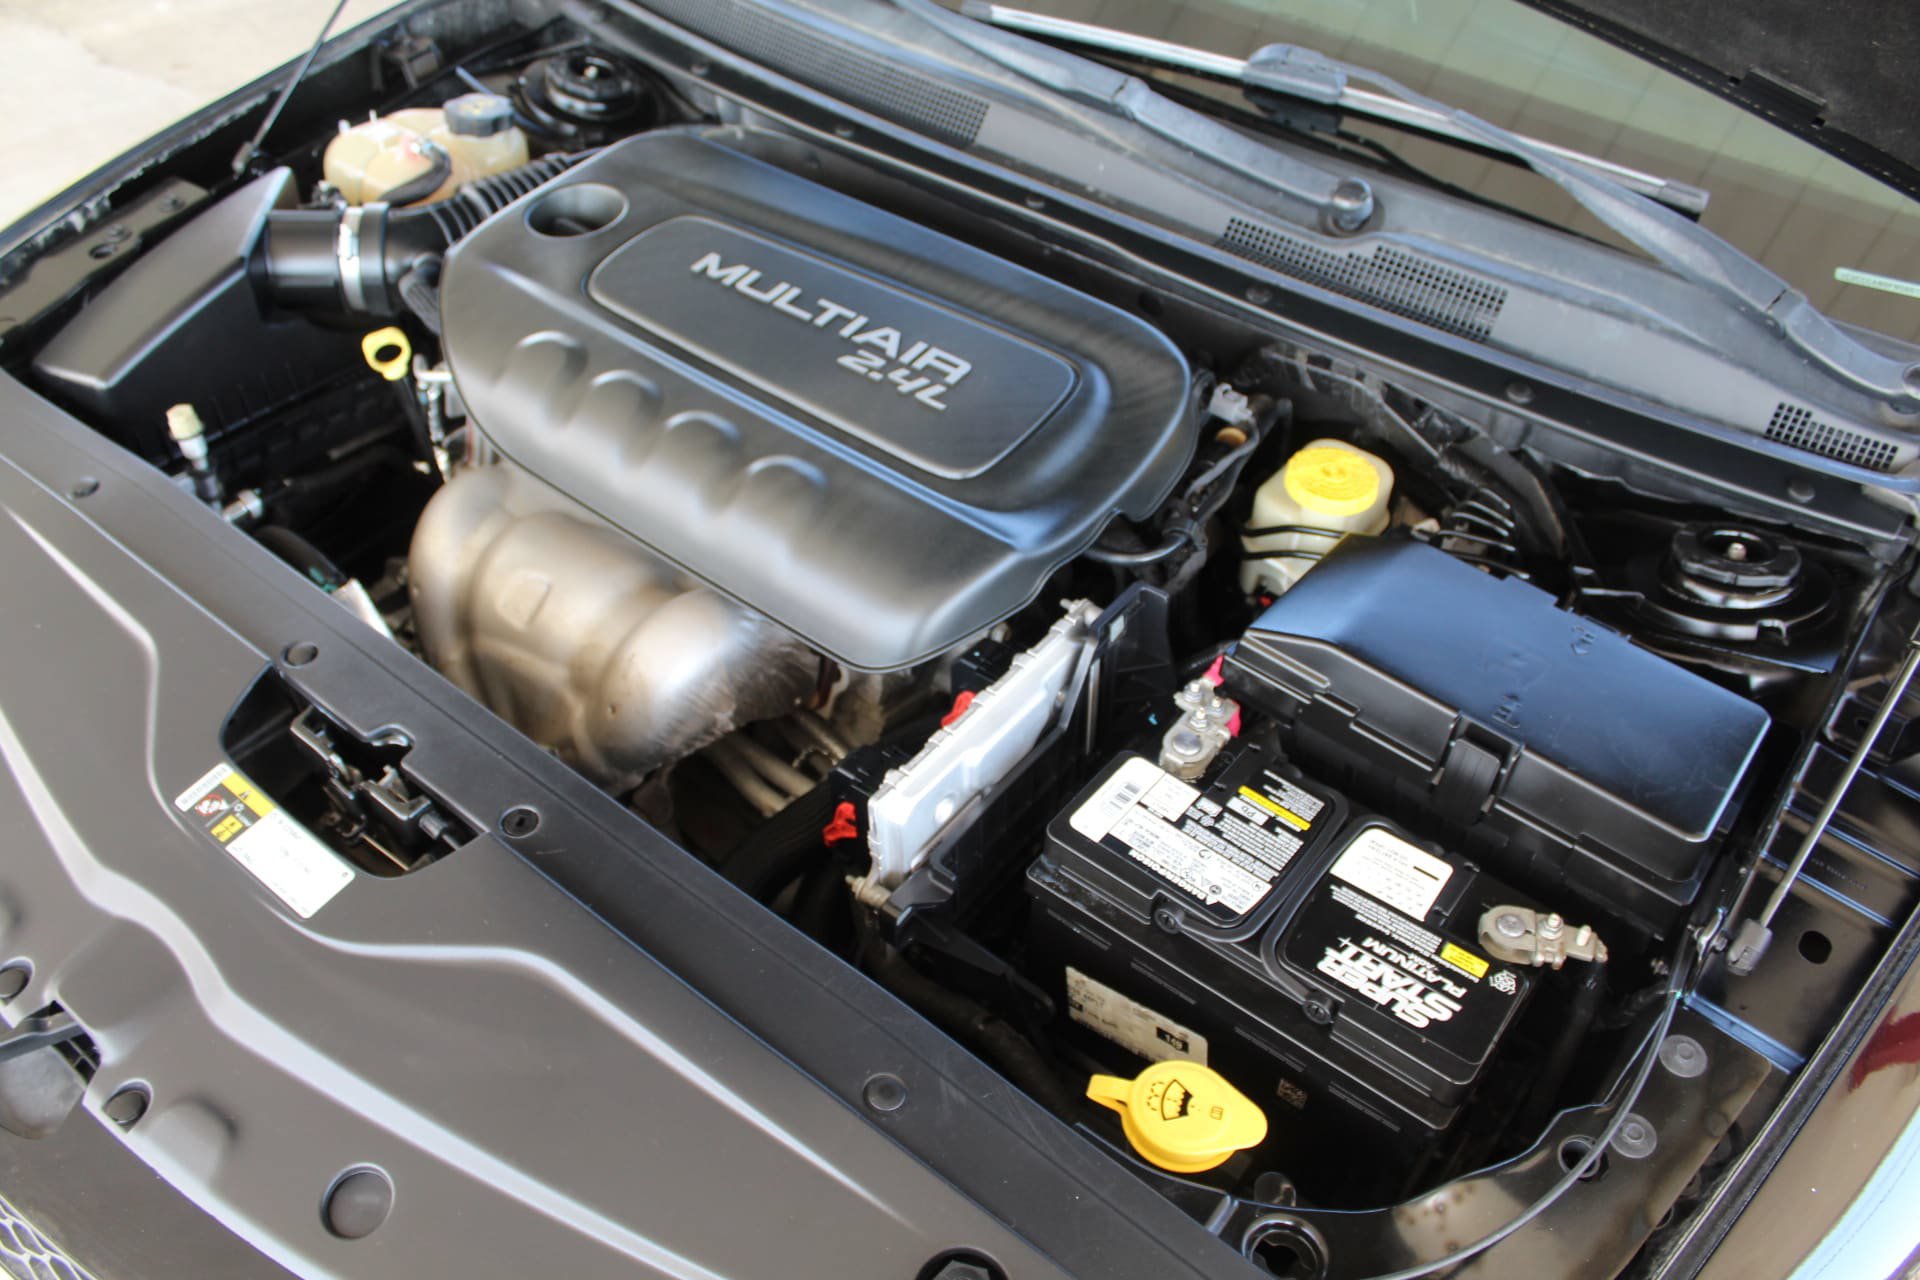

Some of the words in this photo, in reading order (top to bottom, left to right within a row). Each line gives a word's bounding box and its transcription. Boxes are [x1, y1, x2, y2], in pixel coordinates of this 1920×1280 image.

[690, 251, 972, 385] MULTIAIR
[836, 349, 947, 411] 2.4L
[1241, 804, 1256, 818] Pb
[1316, 953, 1431, 1028] SUPER
[1324, 945, 1463, 1021] START
[1361, 936, 1468, 998] PLATINUM
